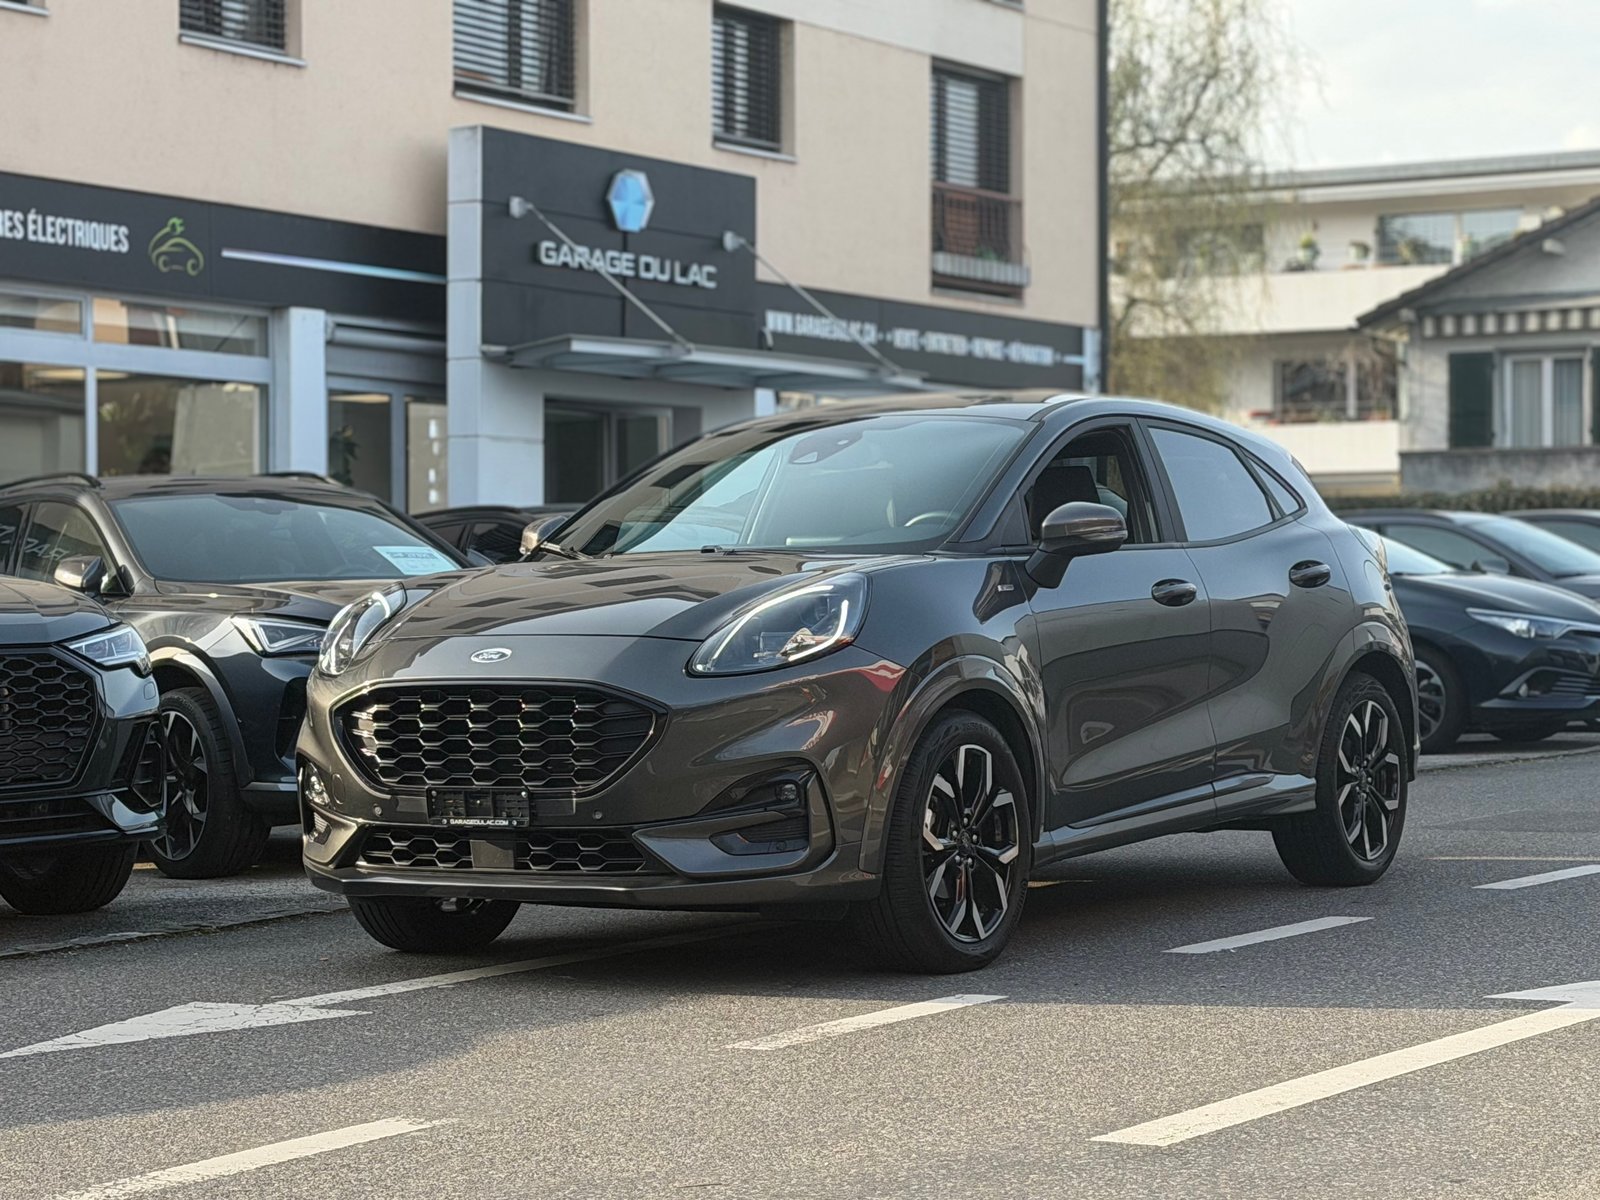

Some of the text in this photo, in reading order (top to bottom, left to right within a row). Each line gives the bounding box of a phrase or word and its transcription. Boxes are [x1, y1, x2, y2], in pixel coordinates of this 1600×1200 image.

[26, 207, 130, 254] ÉLECTRIQUES
[539, 240, 718, 289] GARAGE DU LAC
